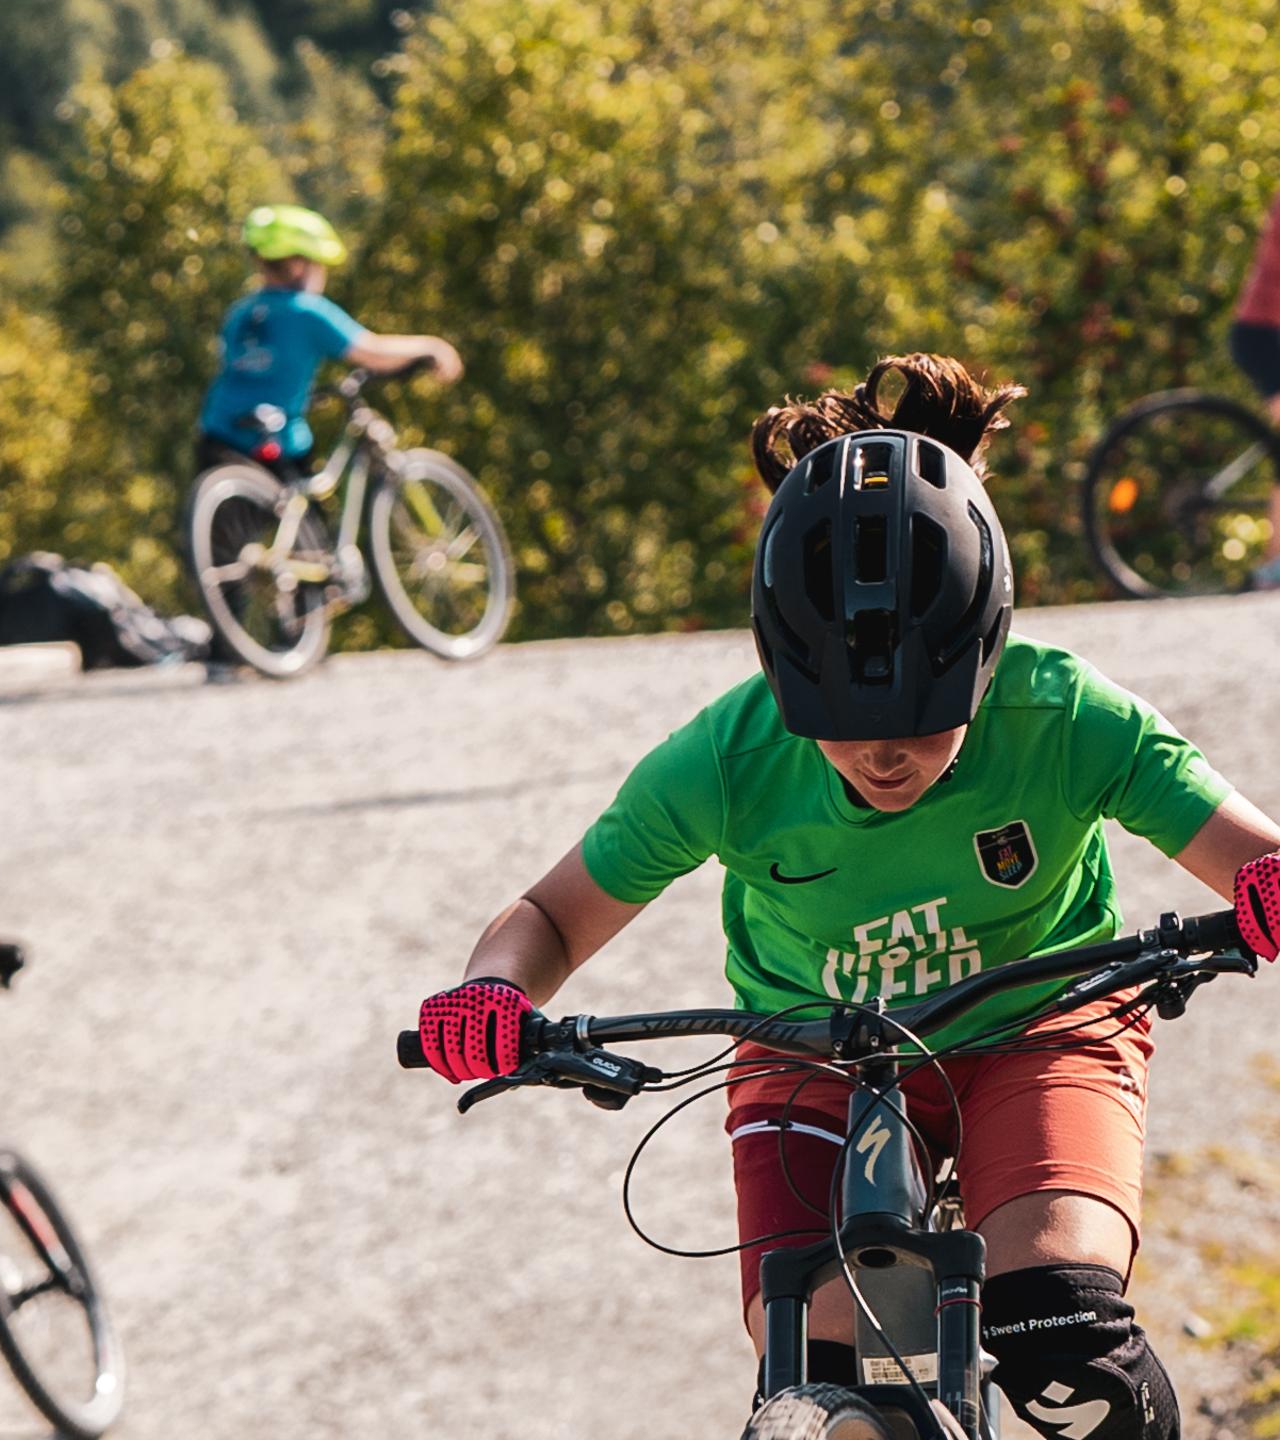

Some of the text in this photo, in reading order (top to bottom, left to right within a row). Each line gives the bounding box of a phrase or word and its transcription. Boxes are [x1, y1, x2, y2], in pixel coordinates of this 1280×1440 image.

[853, 897, 947, 956] EAT
[990, 1311, 1097, 1336] Sweet Protection
